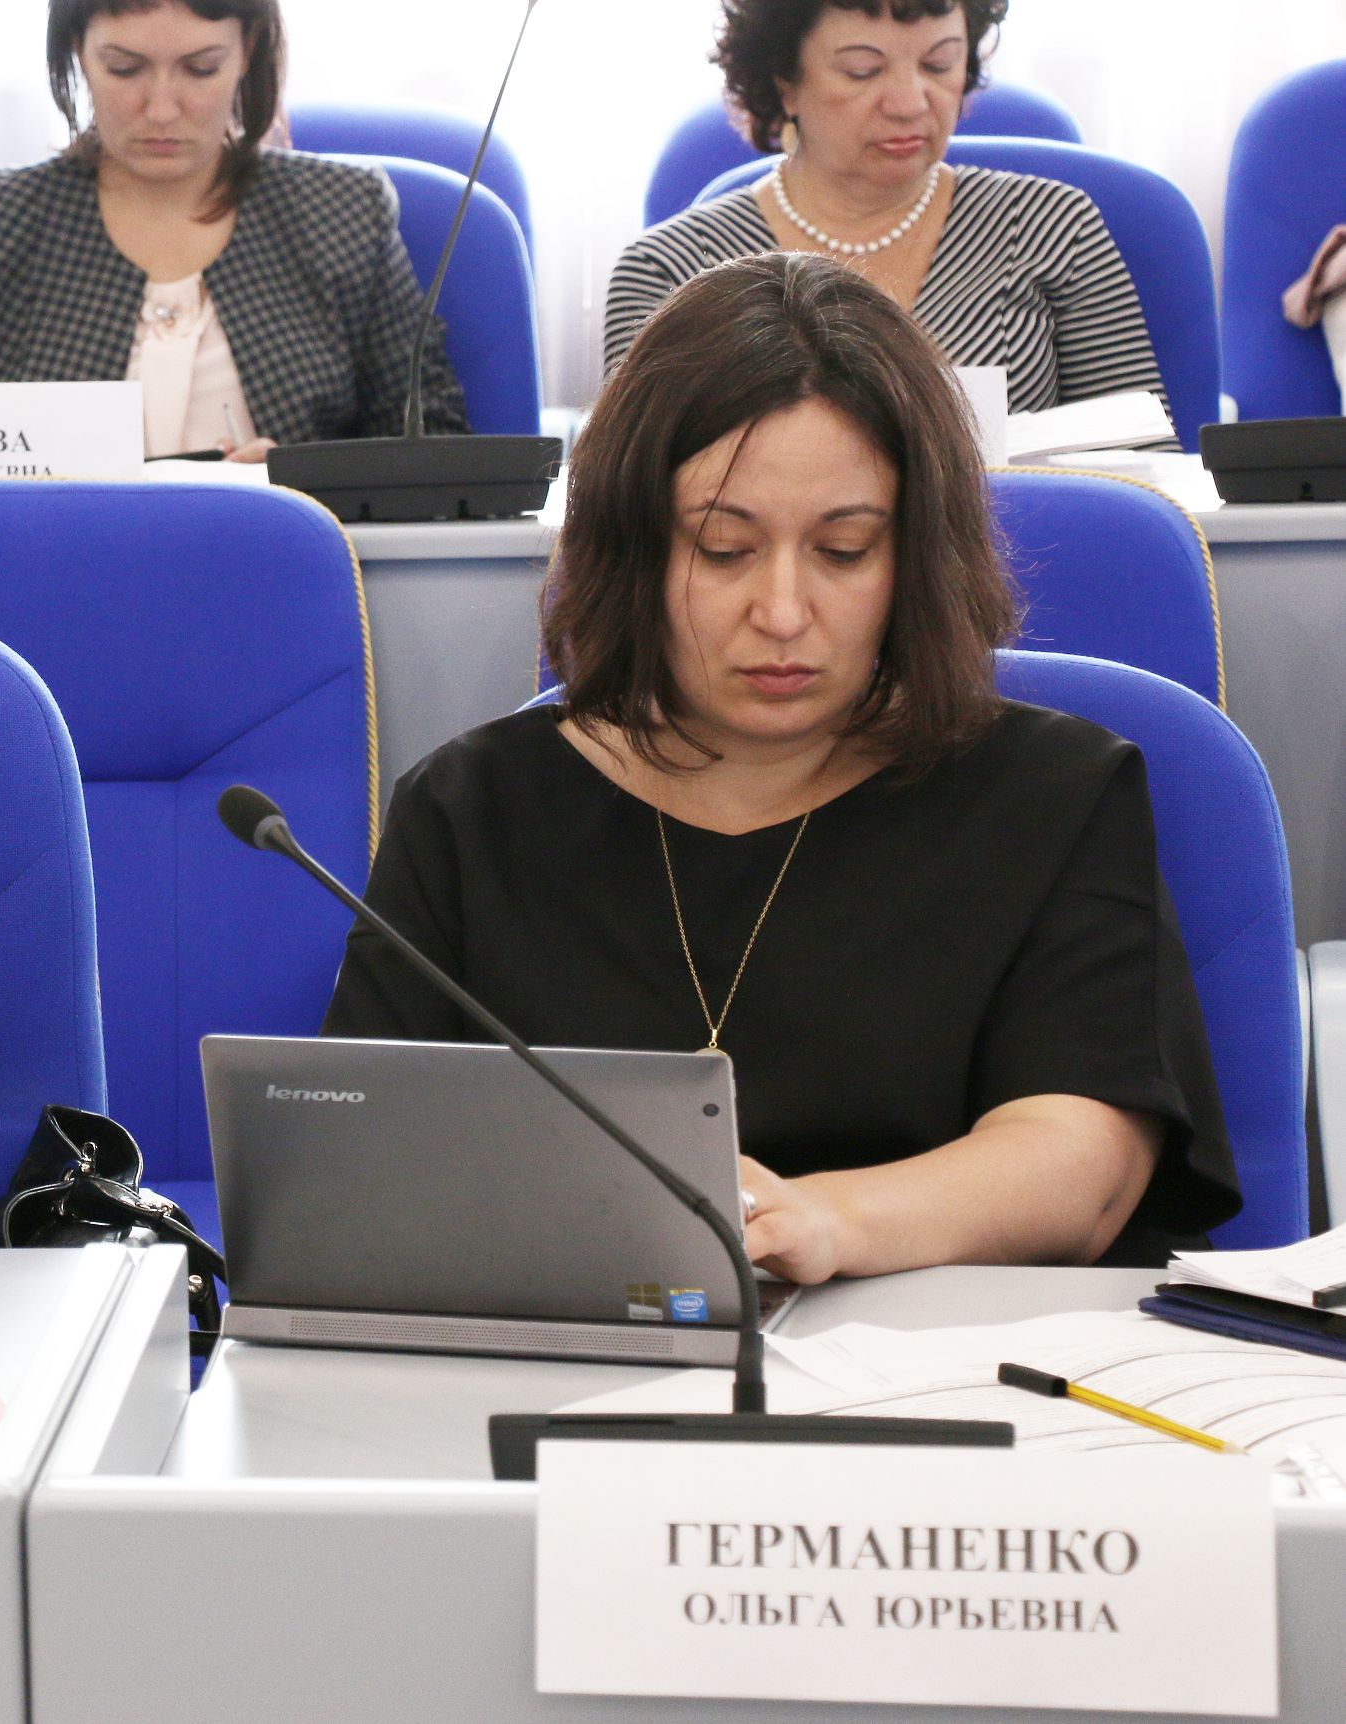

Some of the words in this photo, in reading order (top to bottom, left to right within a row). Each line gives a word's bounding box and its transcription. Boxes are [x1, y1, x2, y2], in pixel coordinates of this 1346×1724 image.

[266, 1084, 366, 1103] lenovo
[664, 1521, 1141, 1575] ГЕРМАНЕНКО
[683, 1592, 847, 1628] ОЛЬГА
[874, 1594, 1121, 1634] ЮРЬЕВНА
